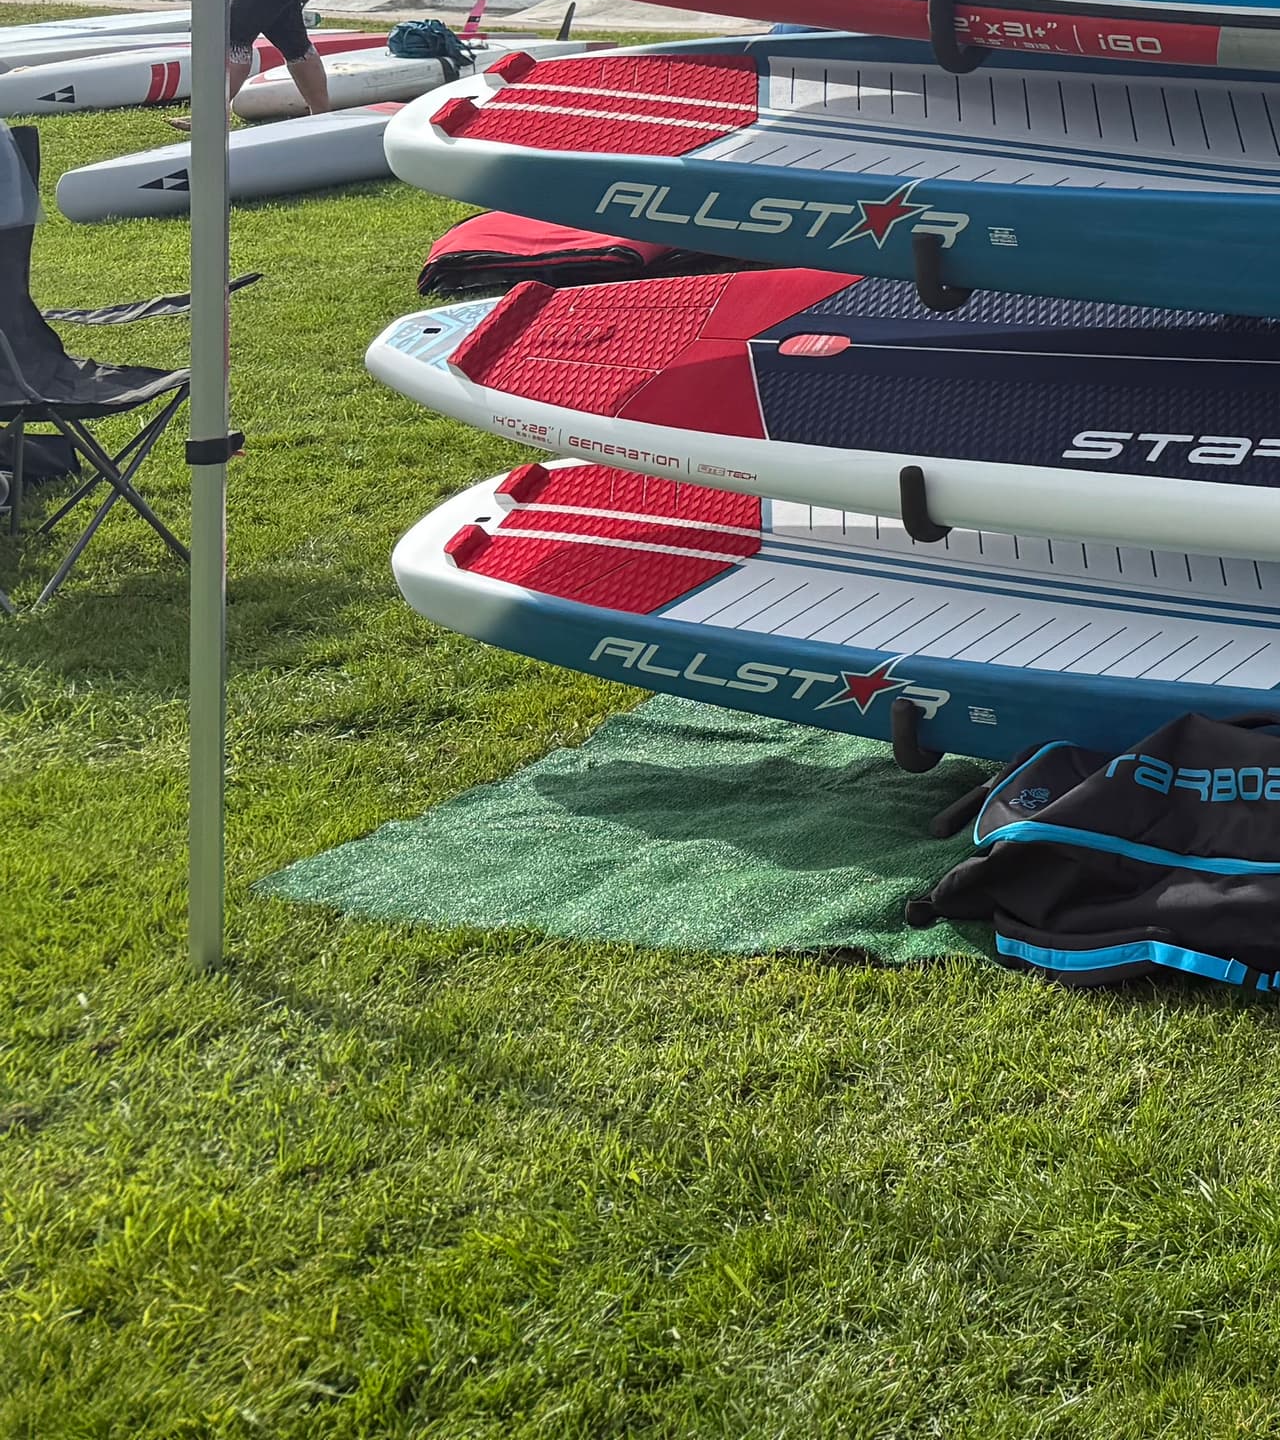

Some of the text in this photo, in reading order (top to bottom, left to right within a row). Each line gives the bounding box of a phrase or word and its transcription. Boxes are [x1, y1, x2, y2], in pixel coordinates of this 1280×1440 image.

[1098, 33, 1163, 55] iGO
[568, 435, 680, 469] GENERATION
[726, 469, 758, 481] TECH
